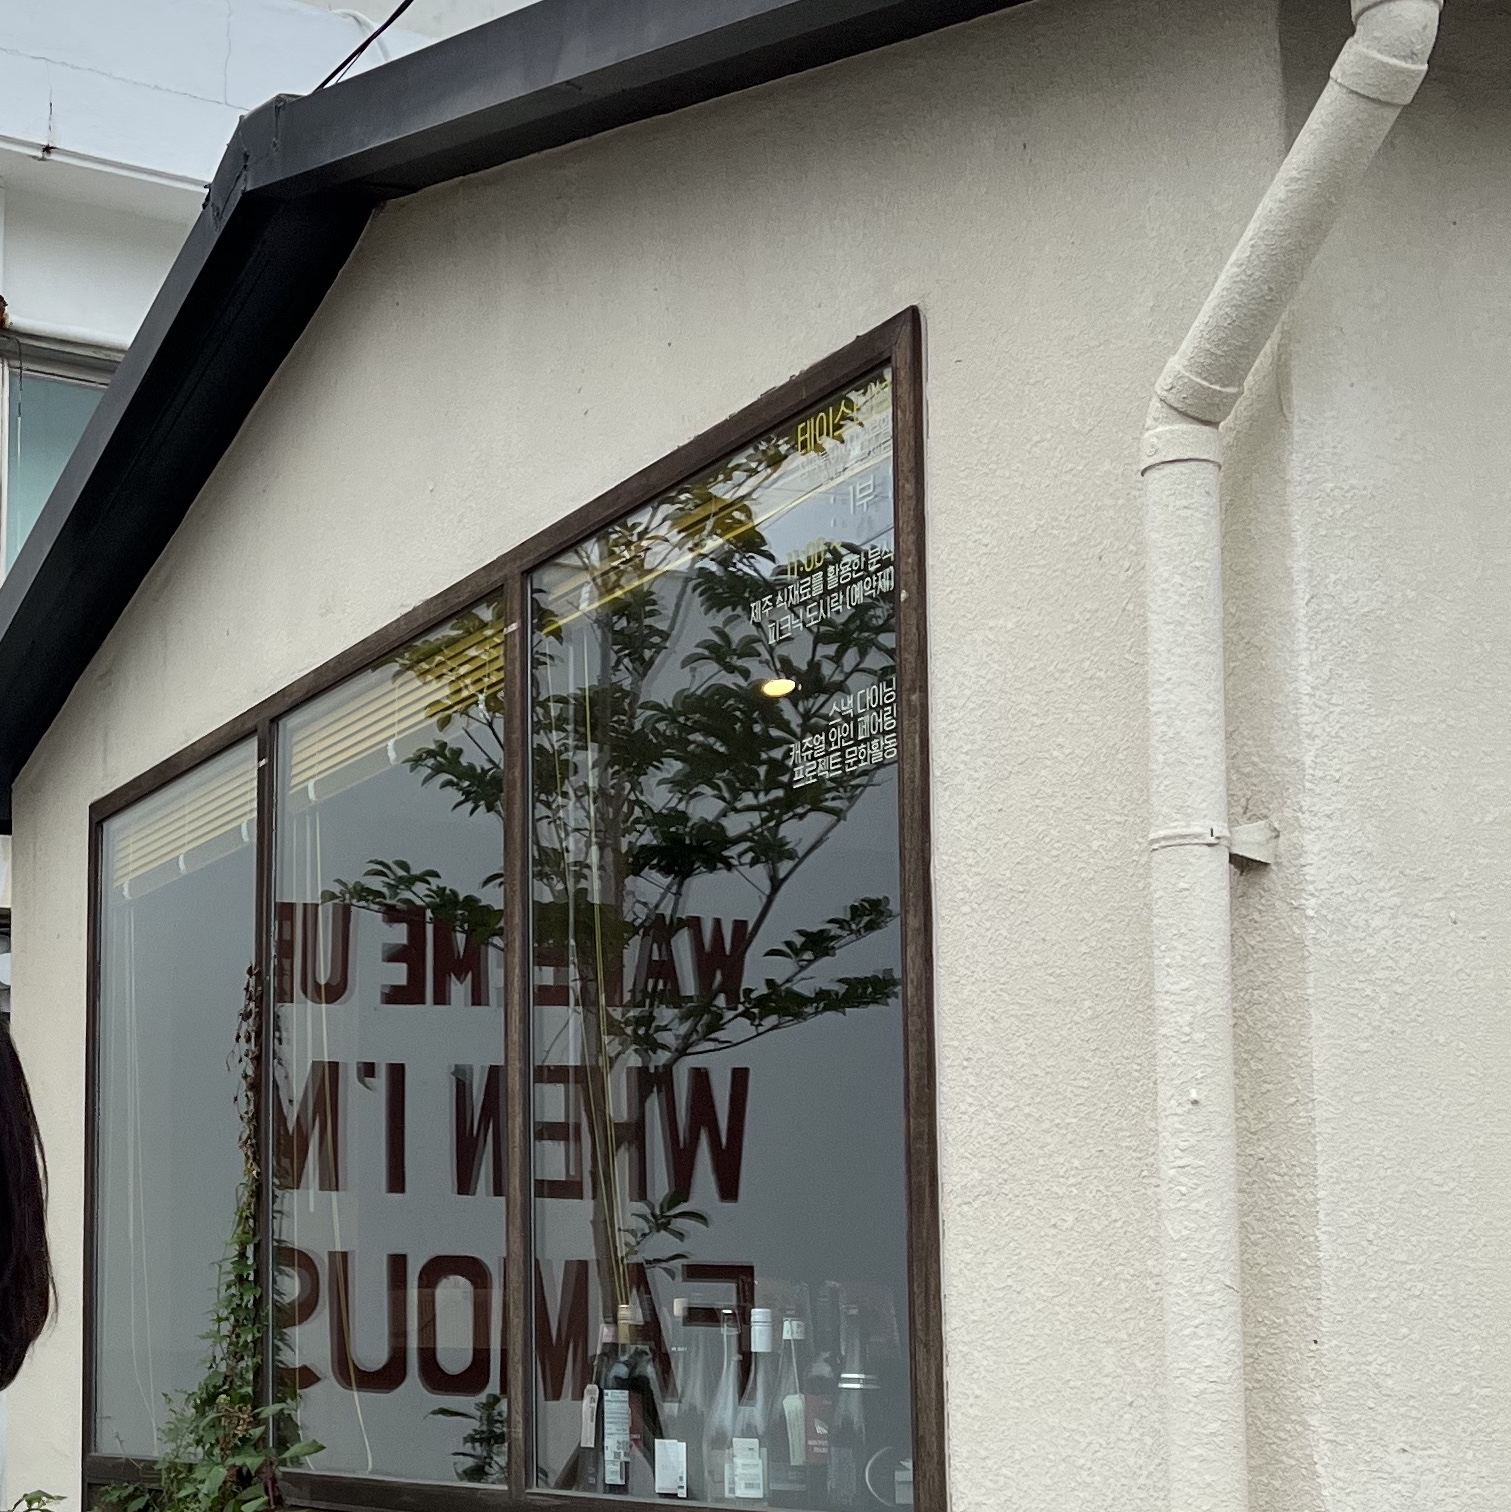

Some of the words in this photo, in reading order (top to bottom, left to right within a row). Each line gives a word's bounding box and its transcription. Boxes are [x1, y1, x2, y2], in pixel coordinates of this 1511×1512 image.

[750, 594, 773, 625] 제주
[776, 571, 824, 611] 식재료를
[827, 551, 865, 590] 활용한
[868, 541, 894, 572] 분식
[768, 608, 804, 644] 피크닉
[806, 590, 843, 628] 도시락
[846, 565, 895, 609] (예약제)
[828, 694, 853, 726] 스낵
[857, 676, 896, 714] 다이닝
[789, 731, 826, 766] 캐쥬얼
[828, 720, 855, 751] 와인
[857, 703, 897, 740] 페어링
[793, 751, 843, 788] 프로젝트
[845, 733, 897, 772] 문화활동
